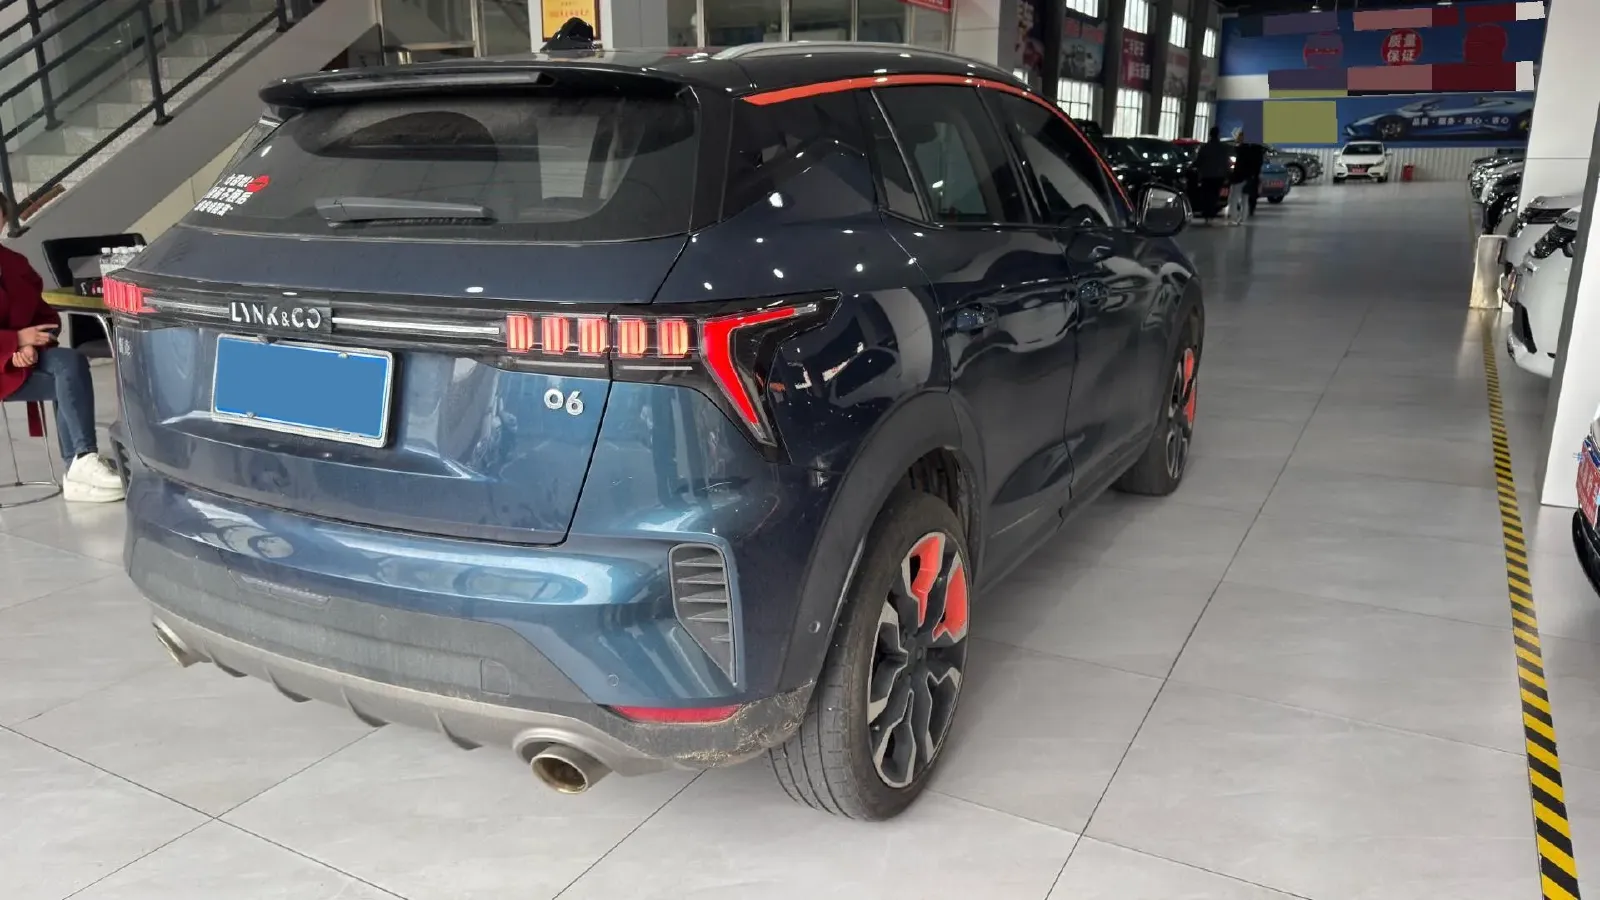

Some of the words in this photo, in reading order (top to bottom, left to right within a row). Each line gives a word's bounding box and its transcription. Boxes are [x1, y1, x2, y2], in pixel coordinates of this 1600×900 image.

[1388, 33, 1416, 48] 质量
[1387, 49, 1416, 62] 保证
[231, 302, 321, 329] LYNK&CO
[543, 388, 584, 416] 06
